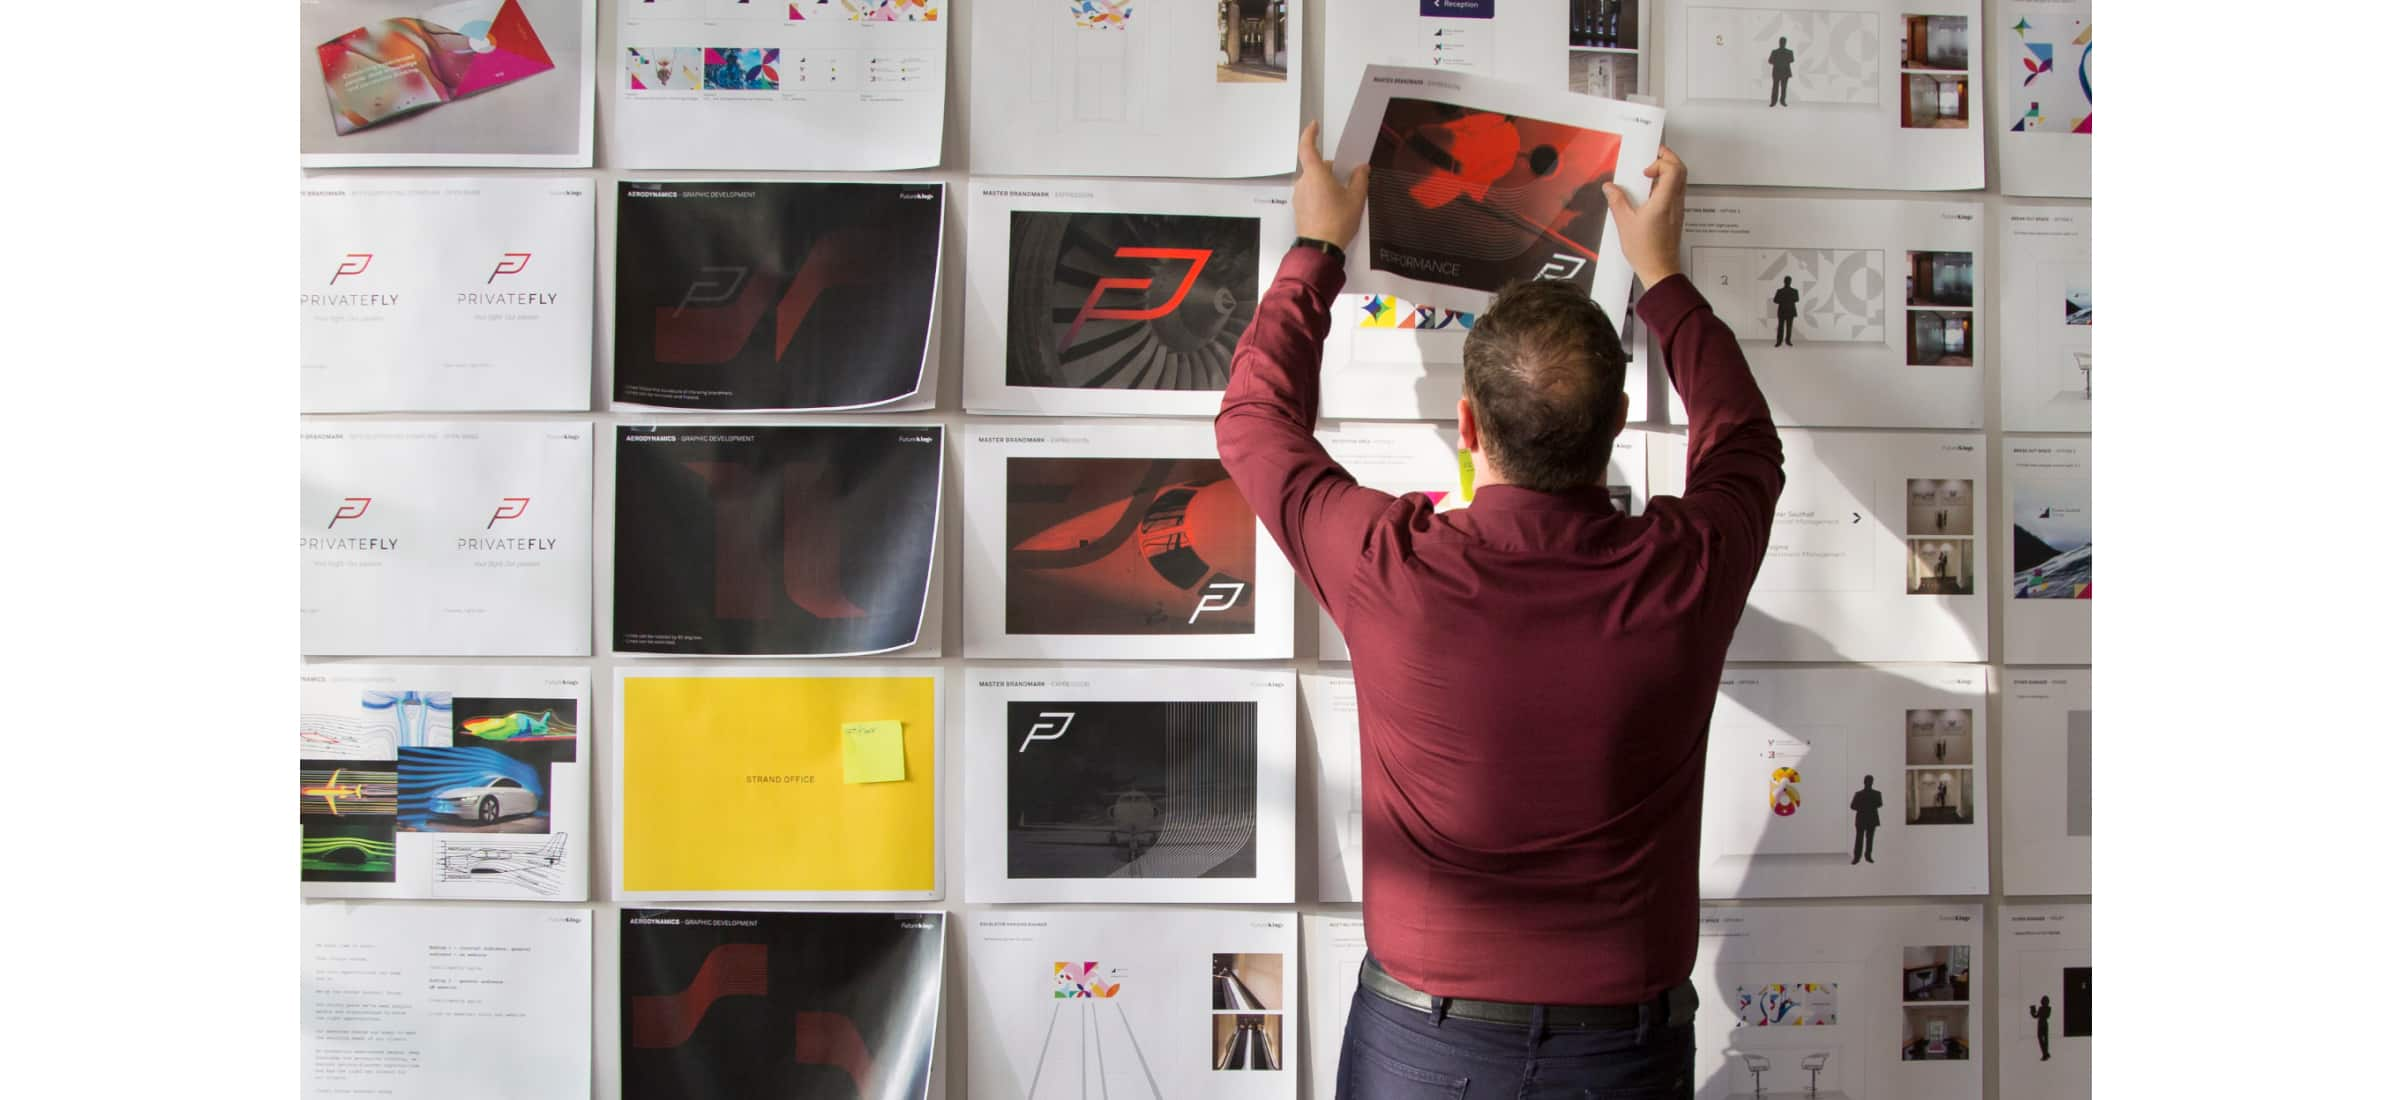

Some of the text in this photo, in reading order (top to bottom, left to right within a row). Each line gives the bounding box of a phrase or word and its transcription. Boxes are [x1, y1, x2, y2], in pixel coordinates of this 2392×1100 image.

[627, 190, 756, 199] AERODYNAMICS GRAPHIC DEVELOPMENT
[1380, 247, 1461, 276] PERFORMANCE
[301, 294, 399, 306] PRIVATEFLY
[457, 293, 557, 305] PRIVATEFLY
[709, 435, 755, 443] DEVELOPMENT
[300, 538, 398, 551] PRIVATEFLY
[457, 538, 557, 550] PRIVATEFLY
[746, 775, 816, 784] STRAND OFFICE
[712, 919, 758, 927] DEVELOPMENT
